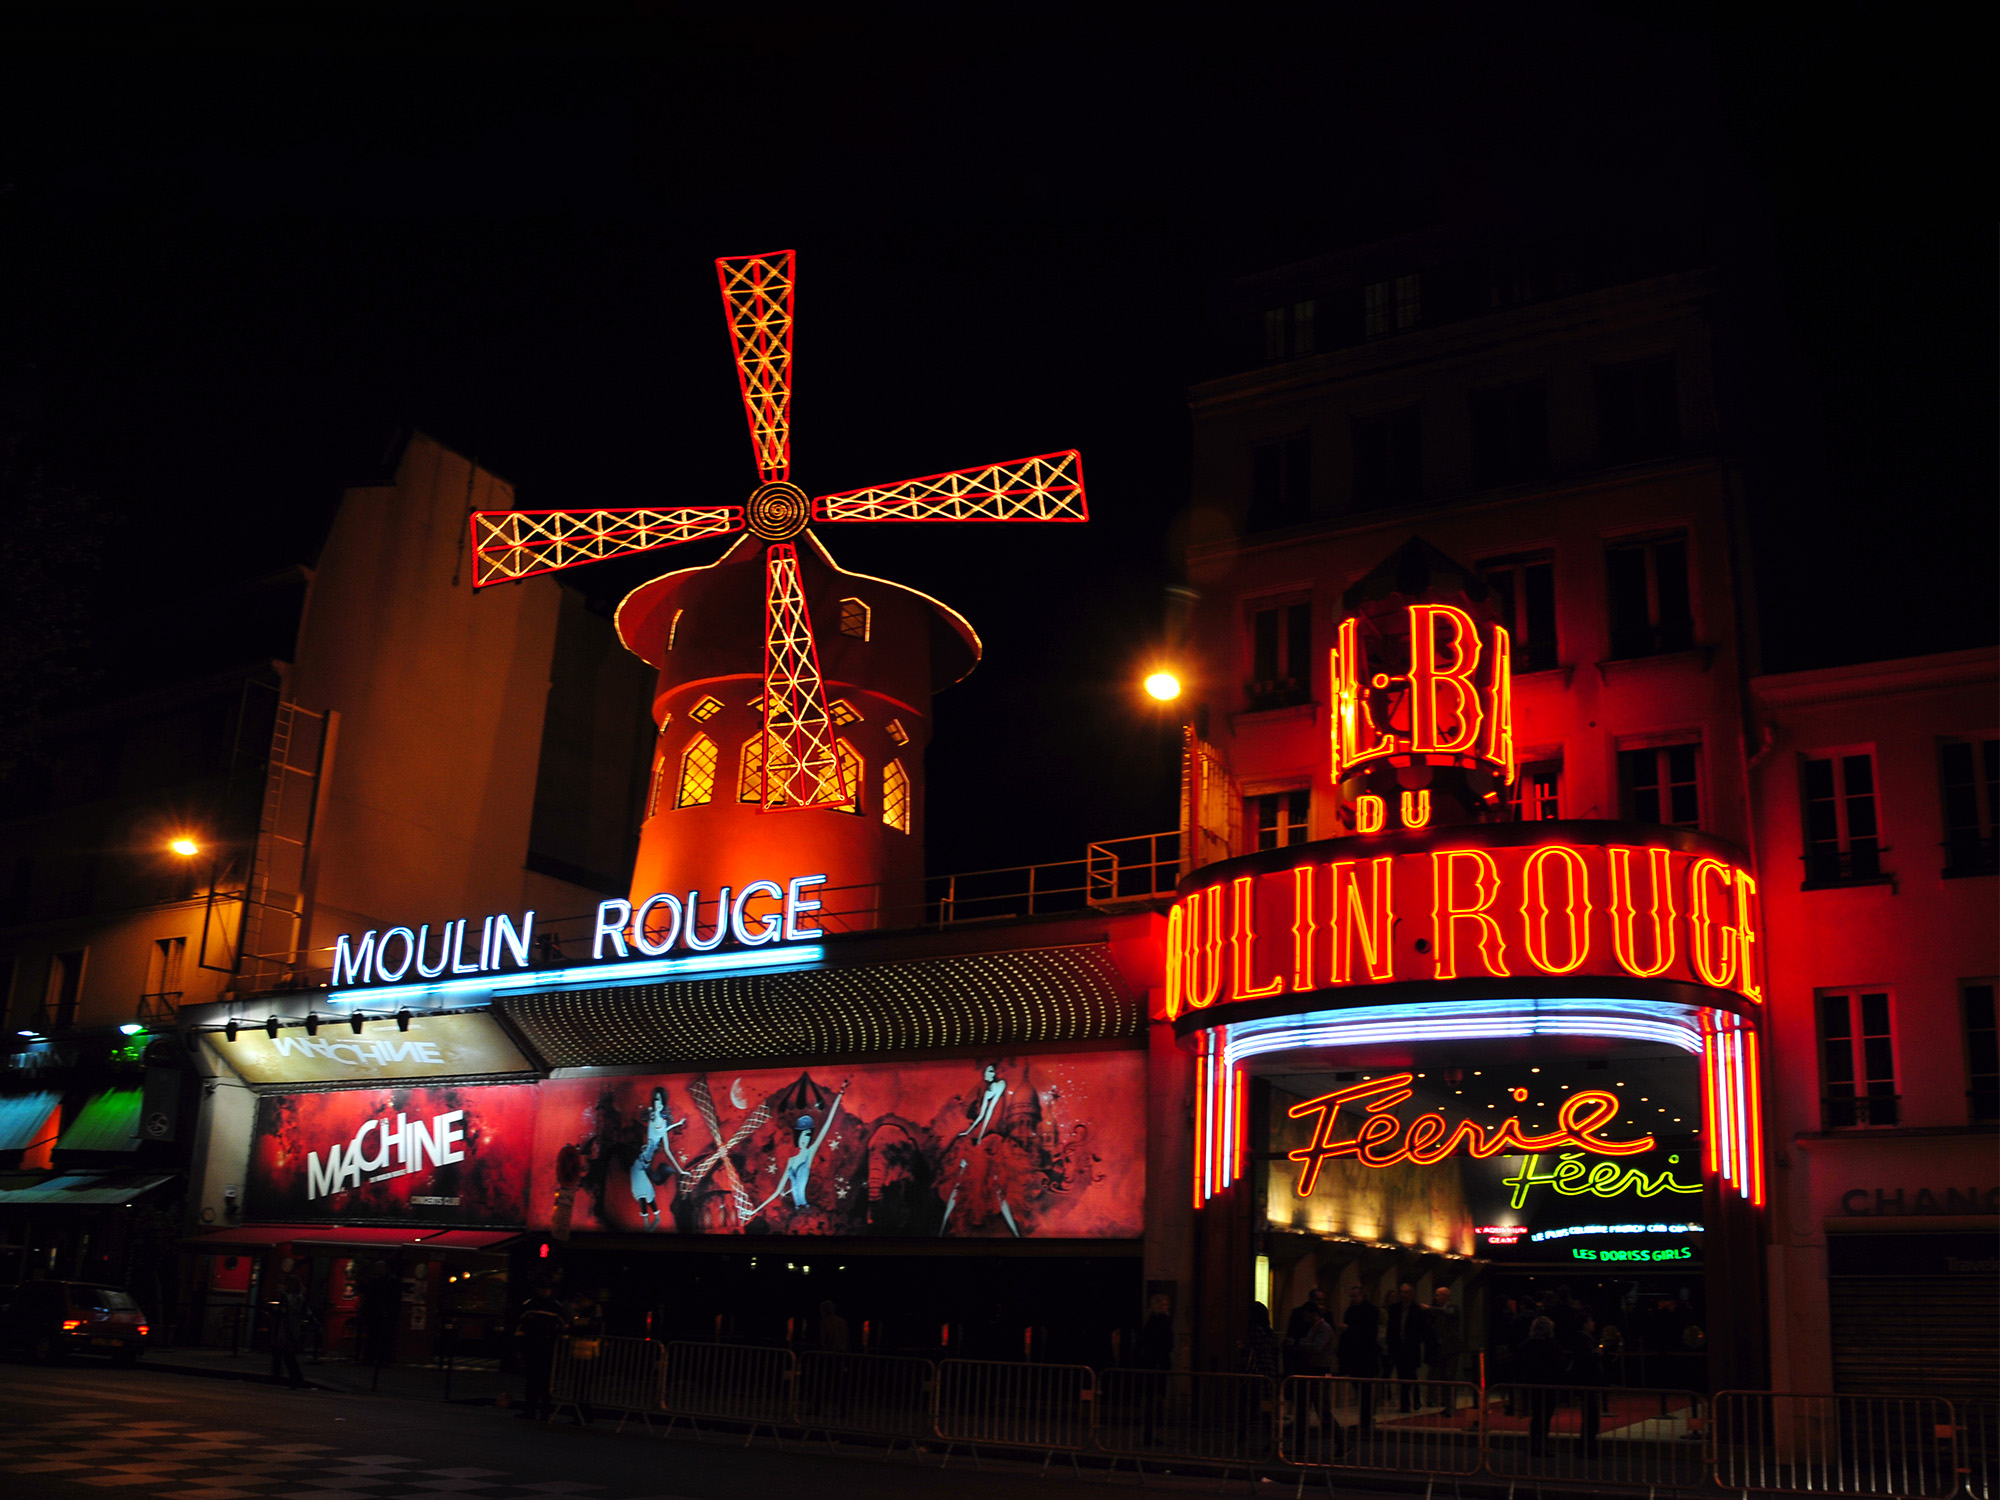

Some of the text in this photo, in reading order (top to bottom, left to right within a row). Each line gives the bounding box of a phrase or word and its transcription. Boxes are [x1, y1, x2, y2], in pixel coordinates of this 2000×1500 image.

[1356, 789, 1431, 833] DU
[330, 874, 828, 987] MOULIN ROUGE
[1431, 845, 1762, 1004] ROUGE
[307, 1109, 465, 1201] MACHINE
[1289, 1072, 1655, 1196] Féerie
[1572, 1246, 1692, 1262] LES DORISS GIRLS
